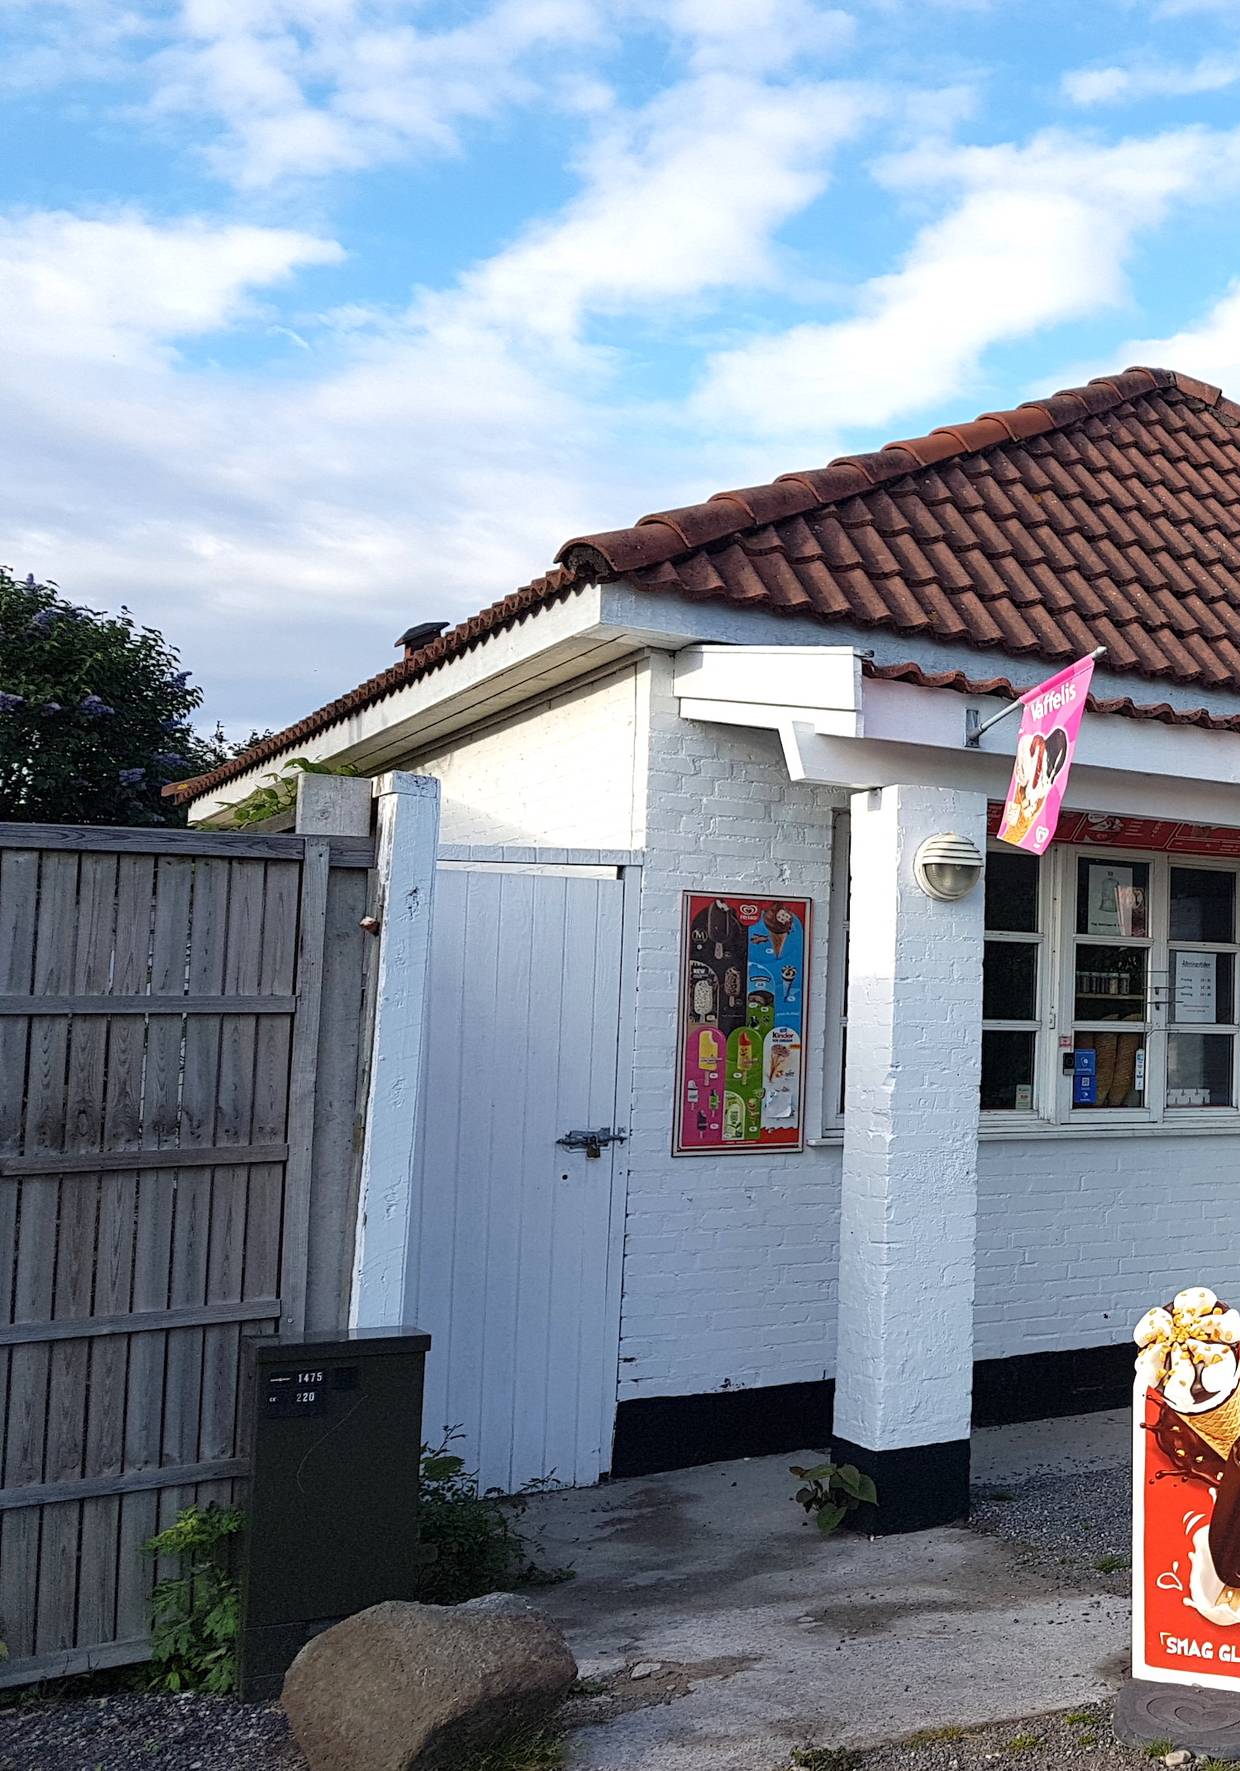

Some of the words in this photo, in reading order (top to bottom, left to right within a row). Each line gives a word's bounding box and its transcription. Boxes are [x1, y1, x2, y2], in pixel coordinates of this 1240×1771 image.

[1031, 682, 1077, 722] Vaffelis
[298, 1371, 323, 1384] 1475
[296, 1391, 315, 1403] 220
[1166, 1636, 1214, 1660] SMAG
